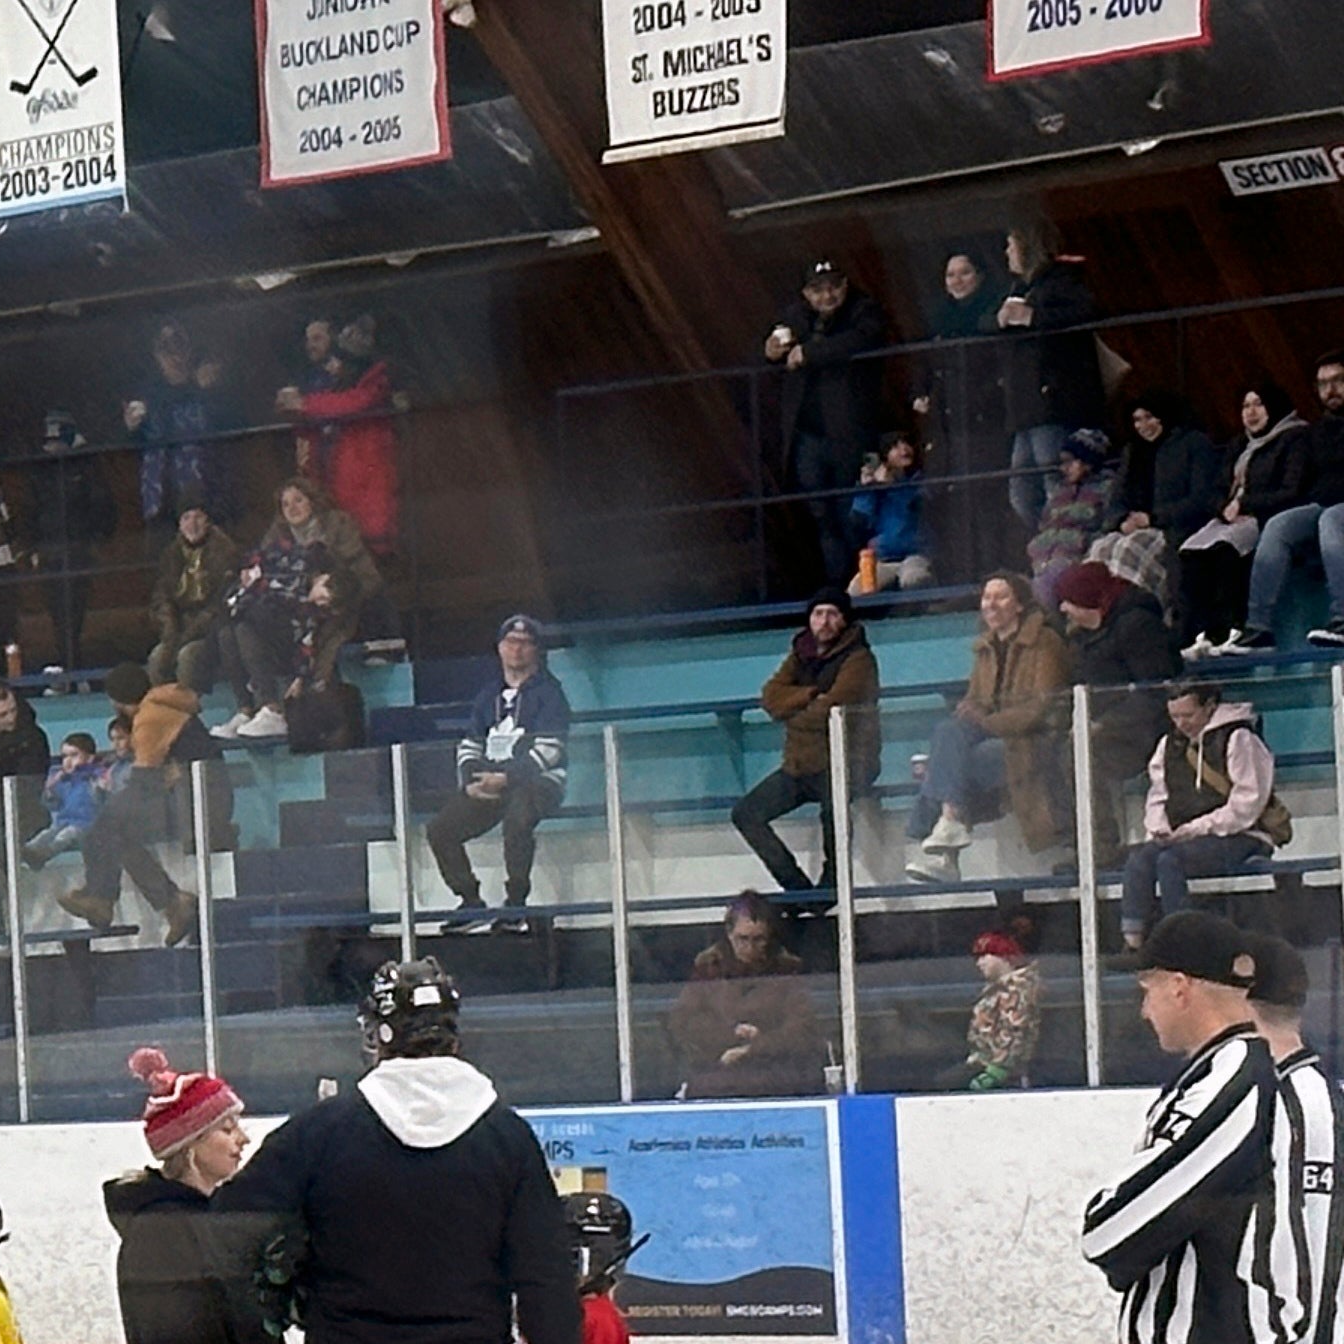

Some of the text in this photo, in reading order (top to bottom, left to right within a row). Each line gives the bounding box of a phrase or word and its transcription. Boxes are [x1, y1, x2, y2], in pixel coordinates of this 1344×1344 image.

[633, 0, 686, 34] 2004
[1027, 0, 1082, 32] 2005
[280, 20, 420, 68] BUCKLAND CUP
[632, 34, 772, 83] ST. MICHAEL'S
[297, 68, 405, 111] CHAMPIONS
[653, 77, 740, 119] BUZZERS
[299, 125, 343, 154] 2004
[361, 115, 402, 146] 2005
[0, 153, 117, 202] 2003-2004
[1232, 152, 1330, 189] SECTION
[1303, 1164, 1334, 1192] 64
